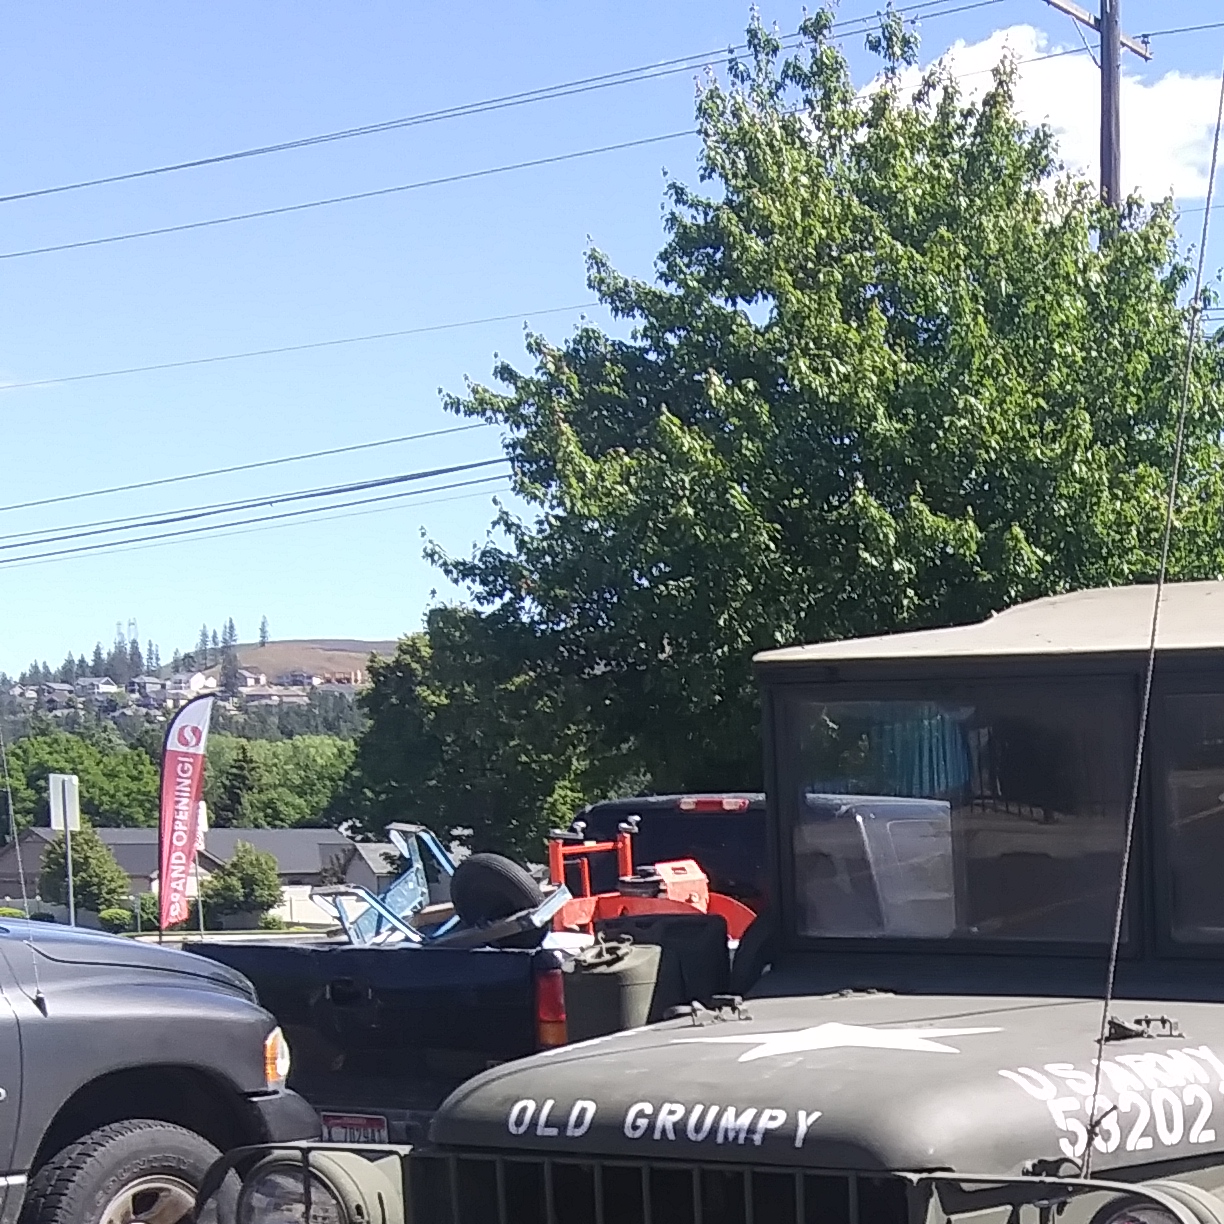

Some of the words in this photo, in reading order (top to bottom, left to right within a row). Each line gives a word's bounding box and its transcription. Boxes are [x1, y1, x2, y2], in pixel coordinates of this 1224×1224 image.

[171, 756, 194, 848] OPENING!
[507, 1098, 597, 1138] OLD
[623, 1100, 823, 1149] GRUMPY
